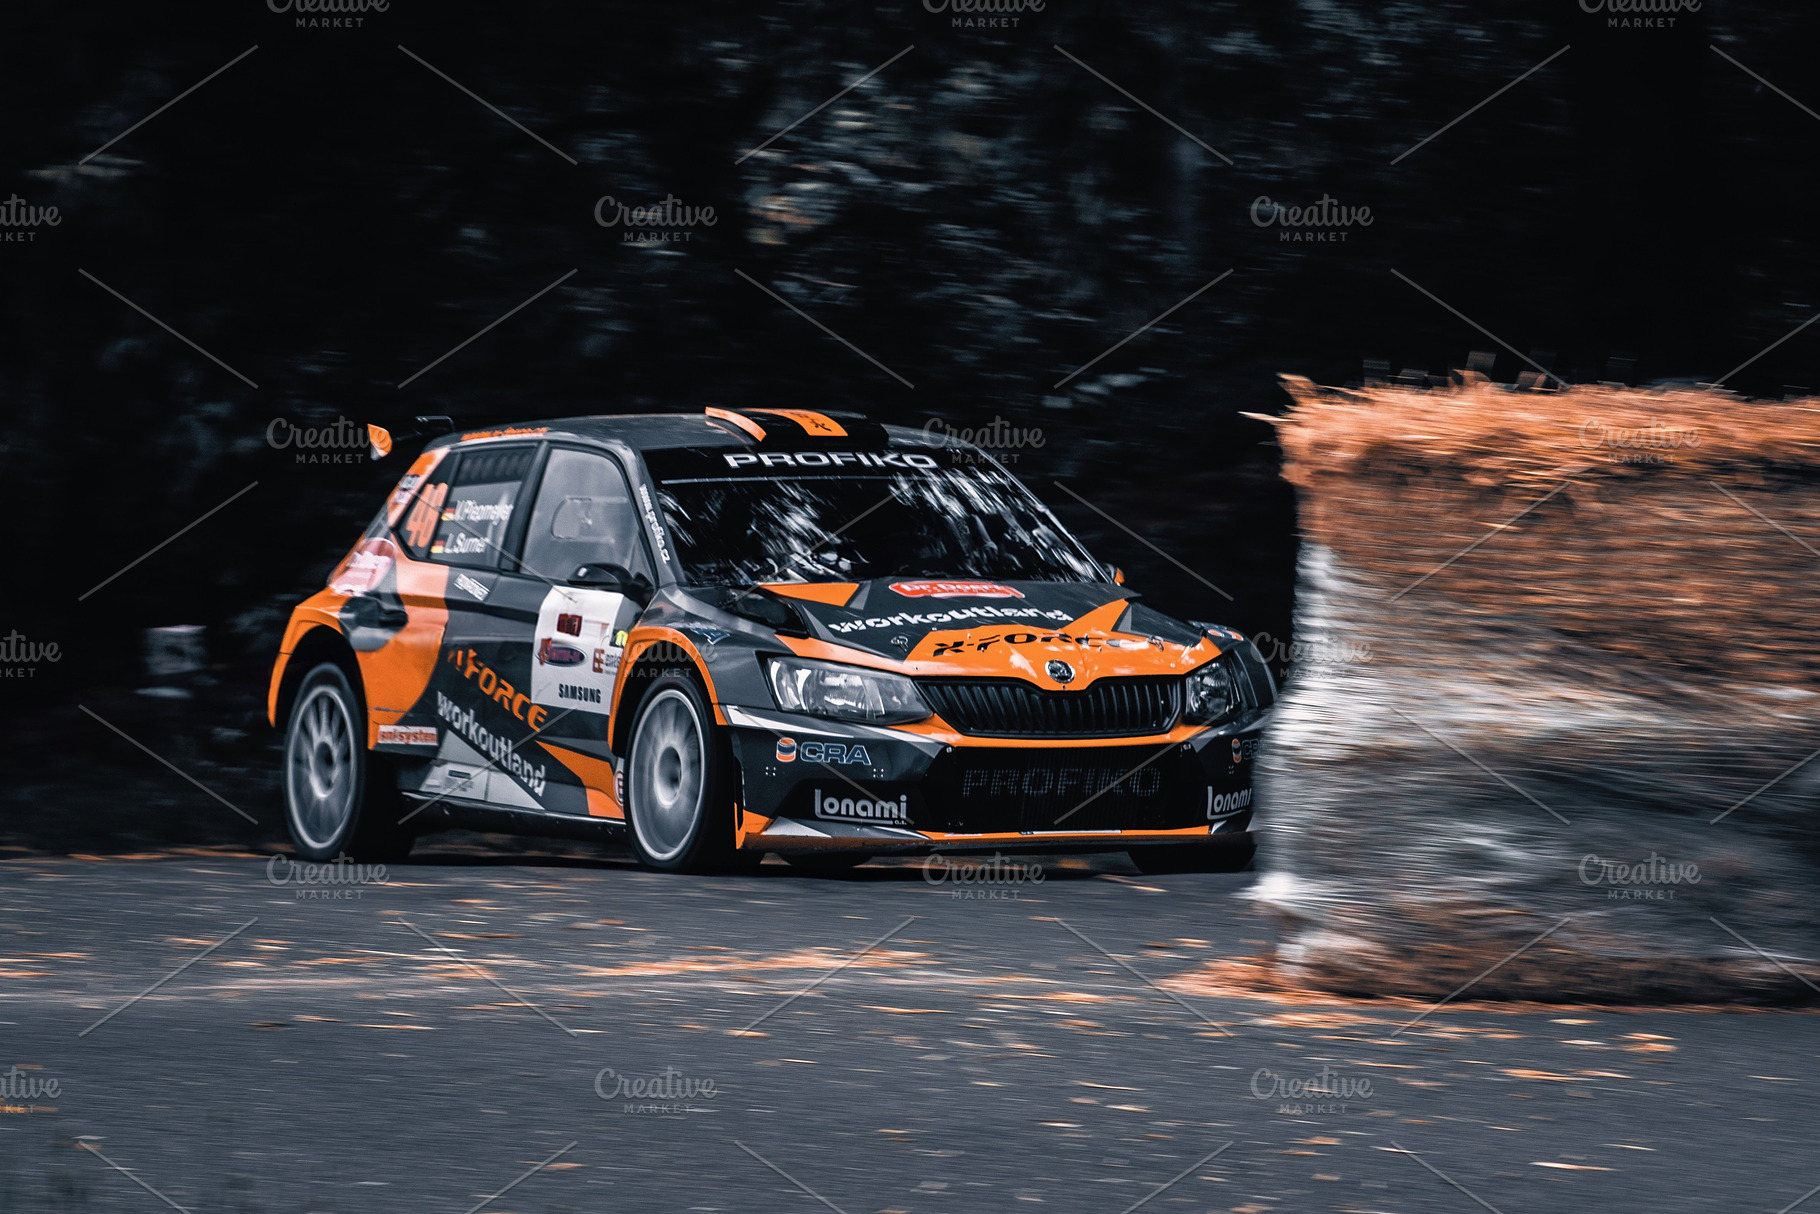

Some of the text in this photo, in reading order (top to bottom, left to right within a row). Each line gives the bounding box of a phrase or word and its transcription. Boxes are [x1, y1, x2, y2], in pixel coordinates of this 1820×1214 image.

[722, 452, 939, 469] PROFIKO
[558, 683, 602, 704] SAMSUNG
[437, 690, 547, 797] workoutland
[799, 741, 872, 765] CRA
[962, 768, 1161, 797] PROFIKO
